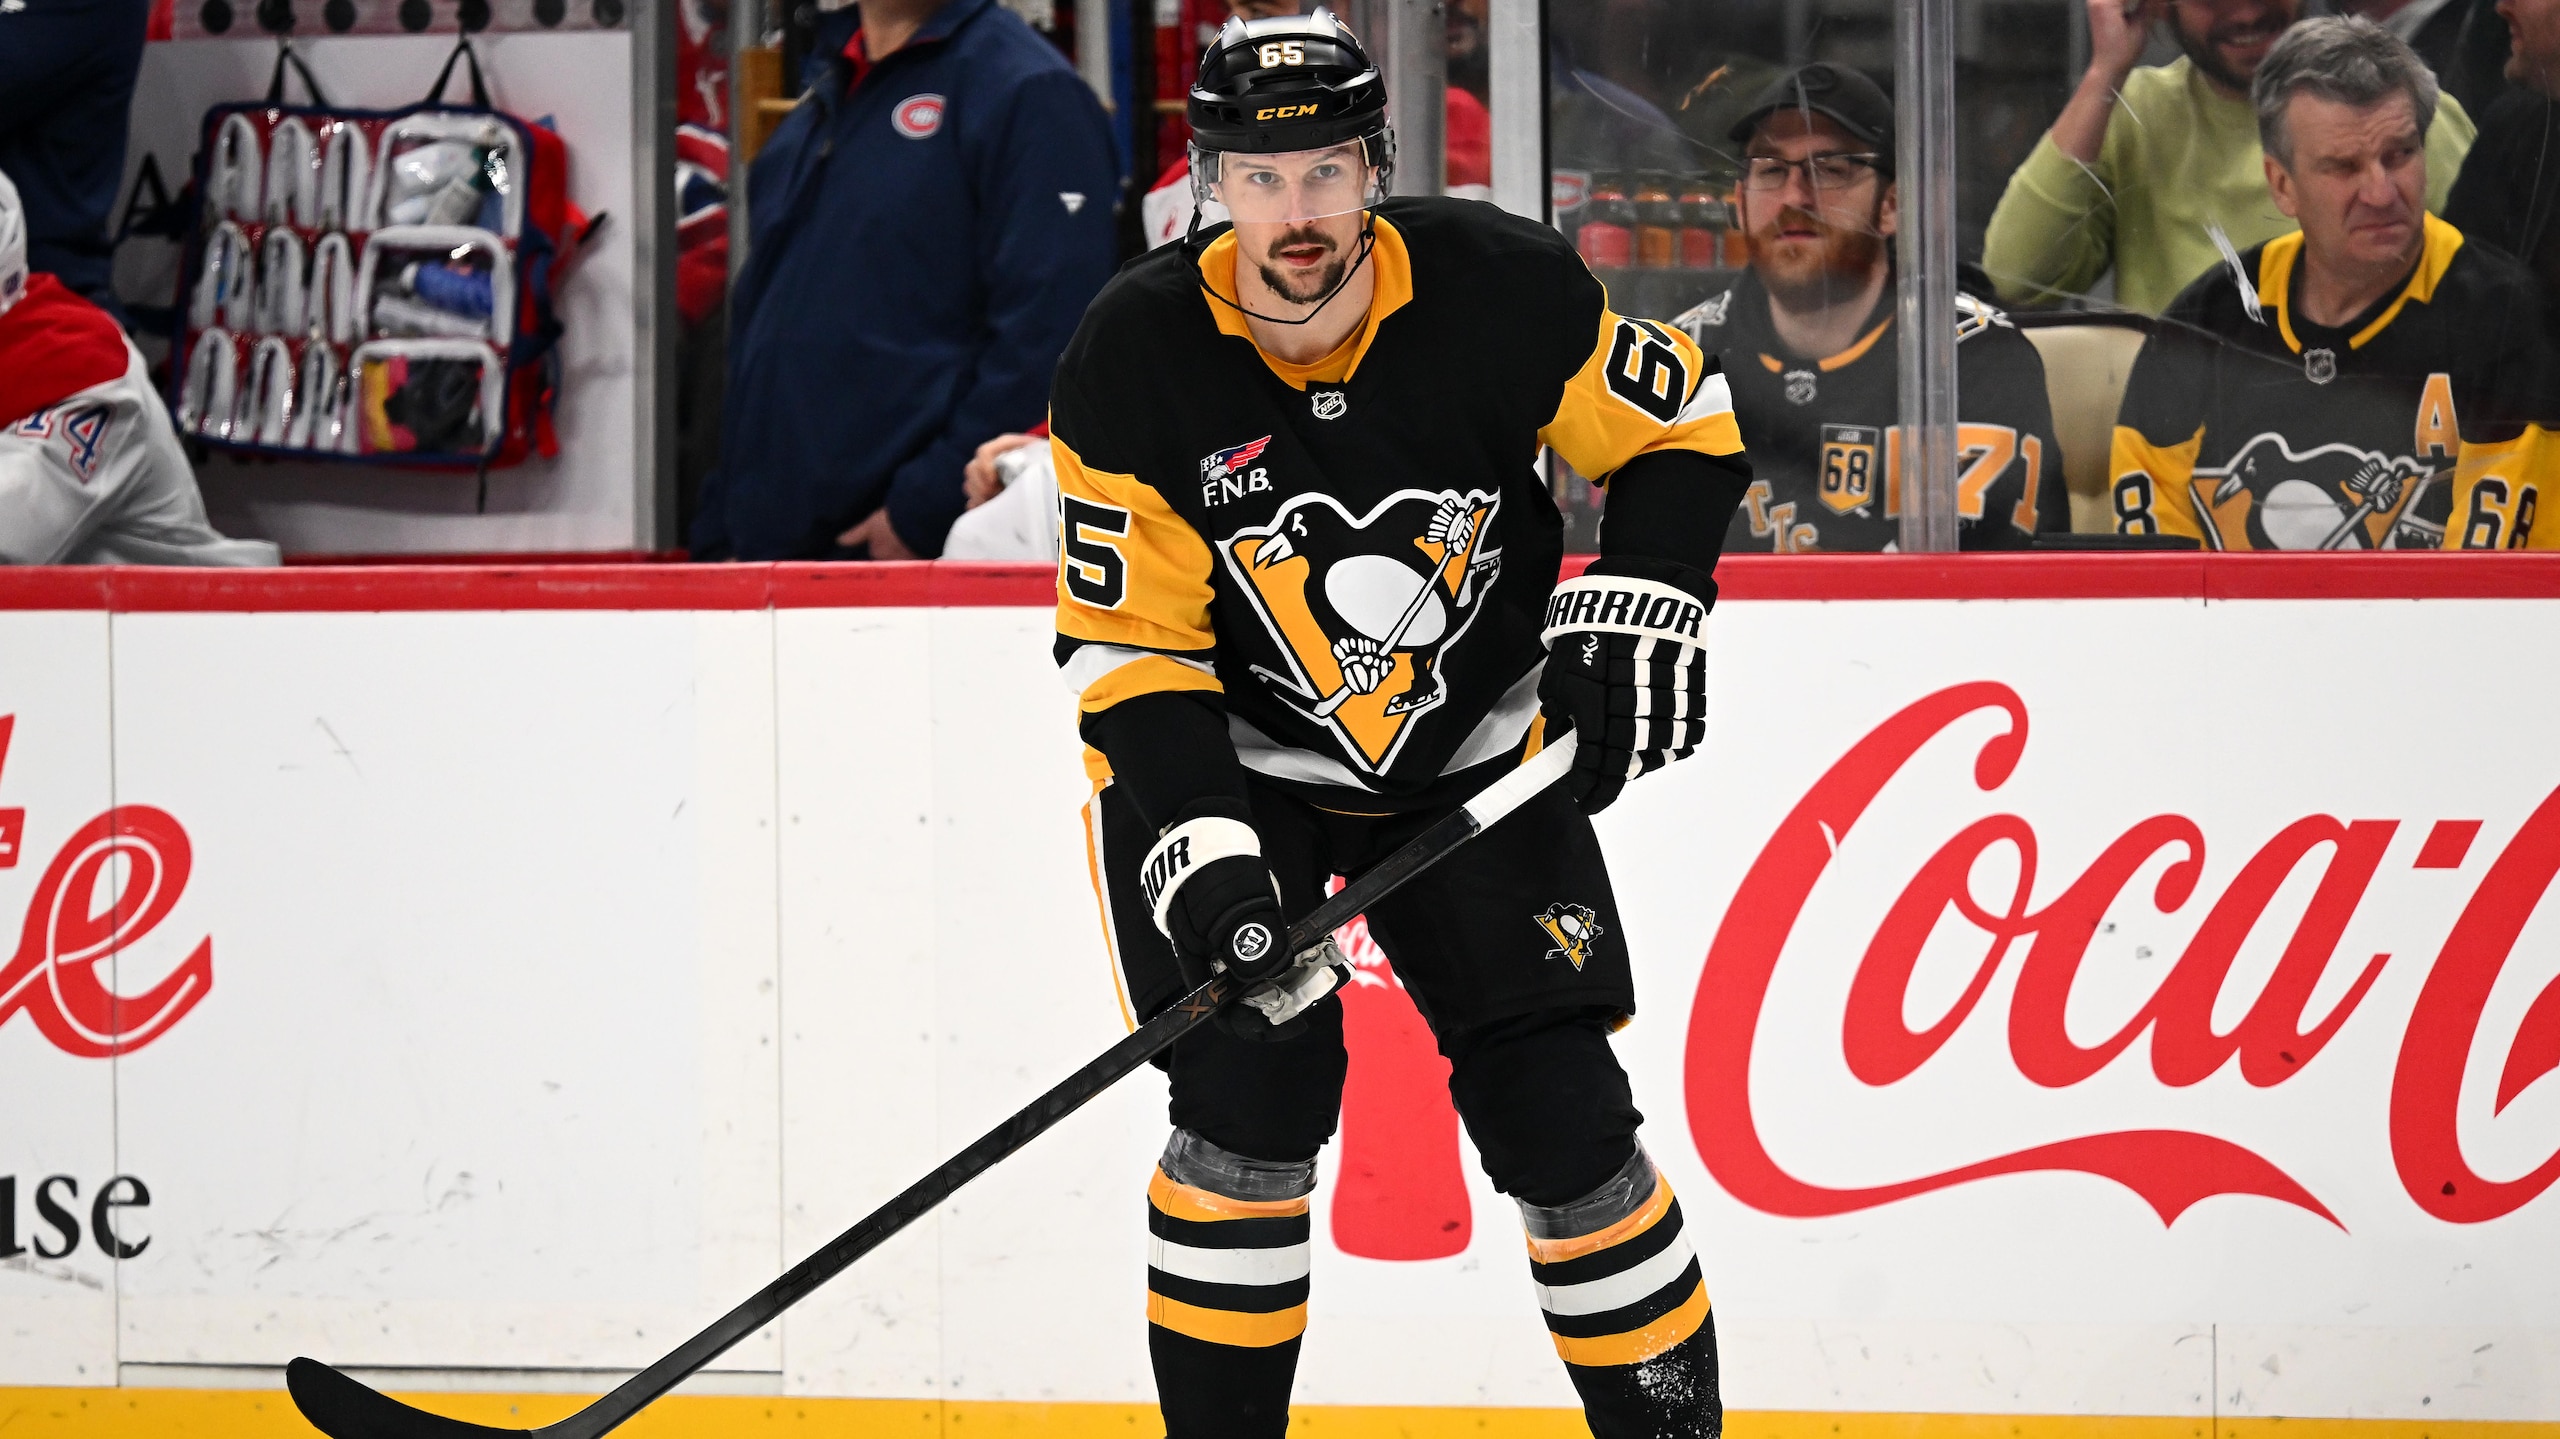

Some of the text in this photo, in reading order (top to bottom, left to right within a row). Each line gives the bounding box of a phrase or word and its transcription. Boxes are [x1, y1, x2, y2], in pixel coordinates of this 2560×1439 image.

[1258, 40, 1306, 69] 65
[1256, 103, 1319, 121] CCM
[1318, 396, 1340, 415] NHL
[2415, 373, 2460, 458] A
[1202, 467, 1274, 508] F.N.B.
[1825, 447, 1869, 496] 68
[2111, 469, 2160, 534] 8
[2461, 474, 2539, 549] 68
[1056, 491, 1132, 611] 5
[1142, 836, 1191, 911] IOR
